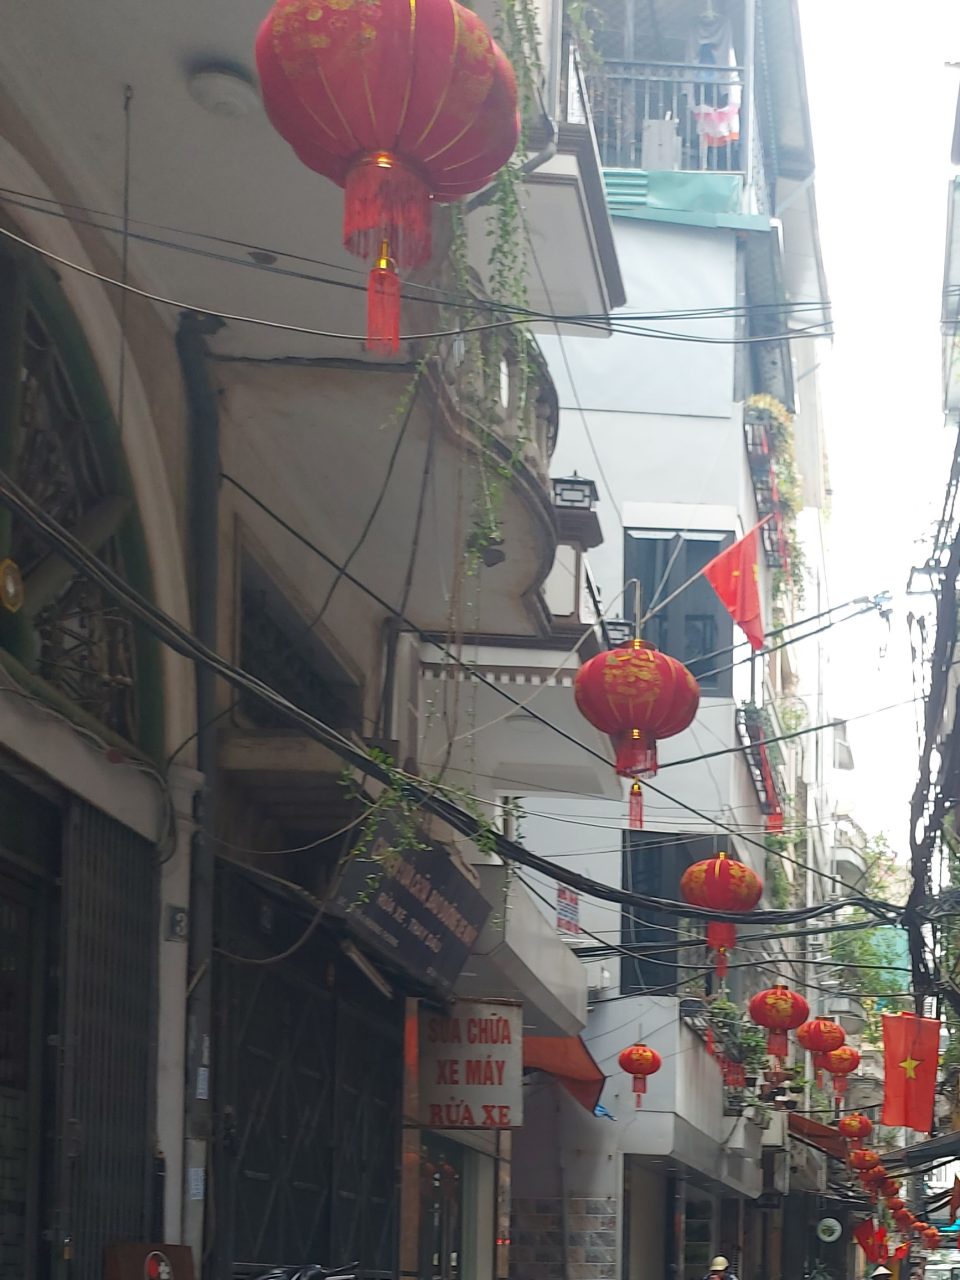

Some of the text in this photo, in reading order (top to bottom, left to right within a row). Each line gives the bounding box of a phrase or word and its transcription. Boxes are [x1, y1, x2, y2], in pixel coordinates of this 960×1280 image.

[467, 1013, 512, 1044] CHỮA
[436, 1054, 505, 1085] XE MÁY
[481, 1104, 511, 1126] XE
